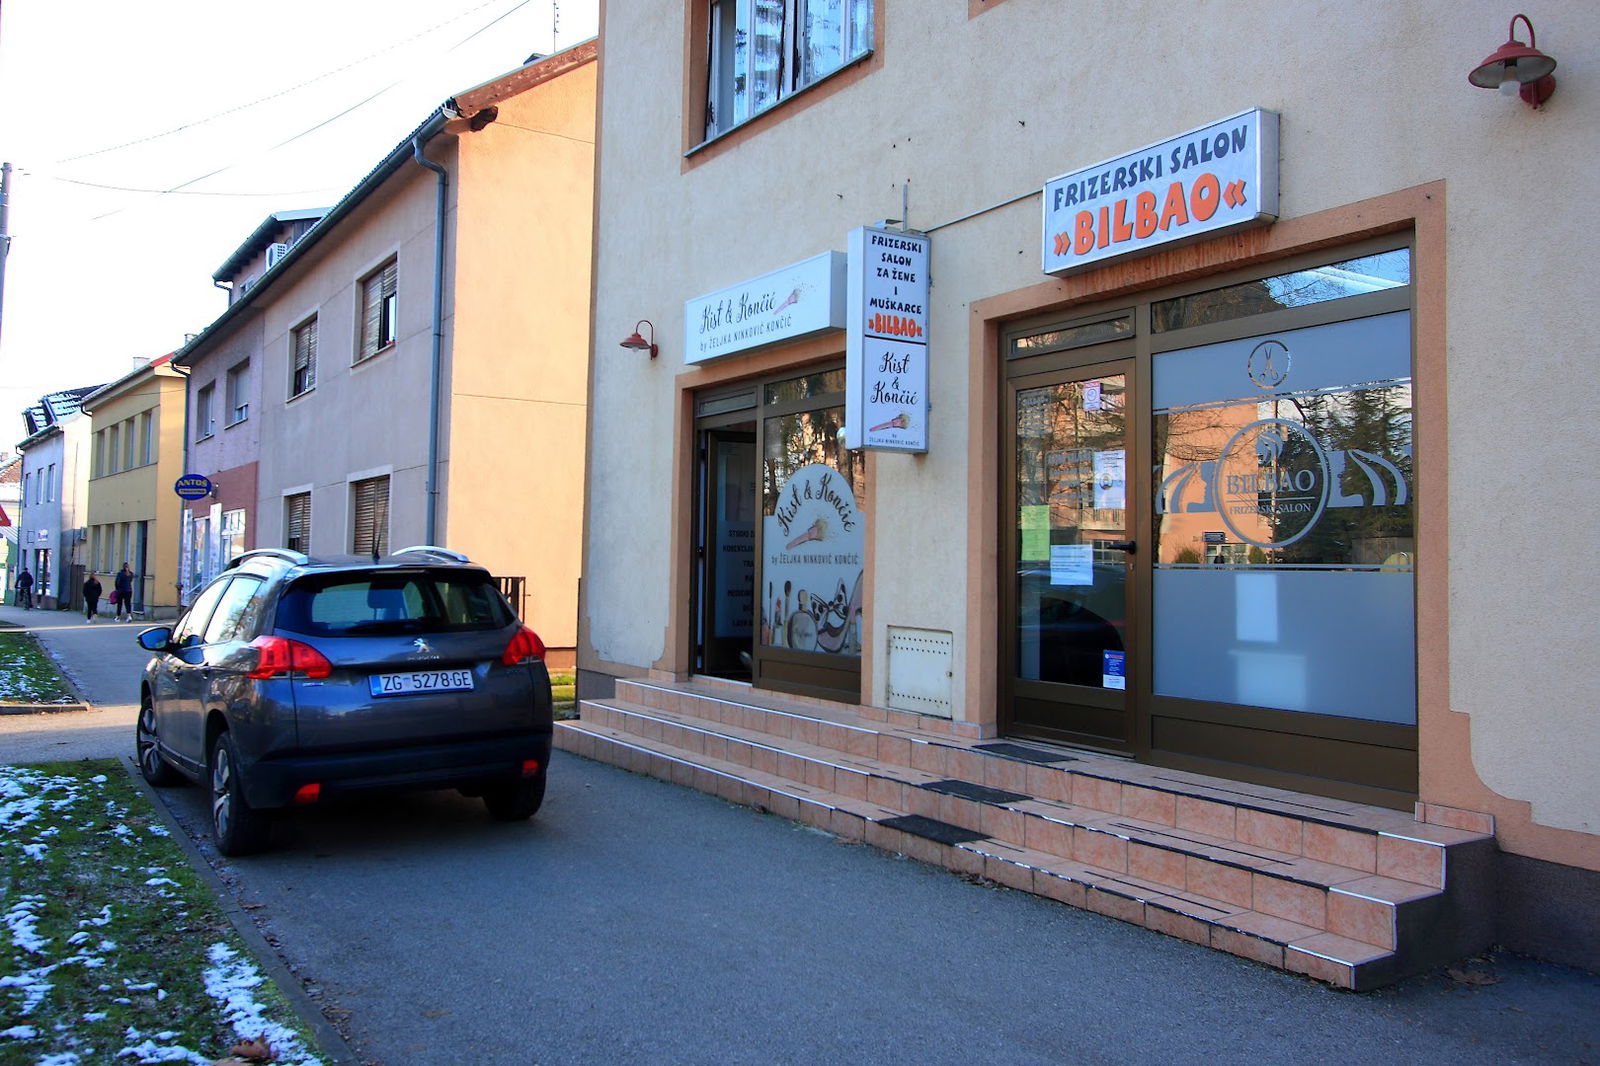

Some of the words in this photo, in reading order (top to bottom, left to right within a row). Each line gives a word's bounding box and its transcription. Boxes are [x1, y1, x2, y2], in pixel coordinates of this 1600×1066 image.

[1053, 154, 1163, 212] FRIZERSKI
[1170, 124, 1248, 174] SALON
[871, 235, 922, 253] FRIZERSKI
[881, 252, 912, 267] SALON
[877, 267, 889, 278] ZA
[892, 267, 916, 283] ŽENE
[894, 286, 898, 296] I
[700, 299, 723, 335] Kist
[725, 298, 733, 324] &
[737, 291, 776, 323] Končić
[870, 297, 922, 315] MUŠKARCE
[766, 313, 792, 333] KONČIĆ
[879, 351, 910, 374] Kist
[891, 376, 900, 391] &
[870, 380, 919, 406] Končić
[1226, 469, 1316, 496] BILBAO
[777, 484, 802, 537] Kist
[803, 479, 813, 500] &
[1278, 501, 1312, 514] SALON
[382, 675, 402, 692] ZG
